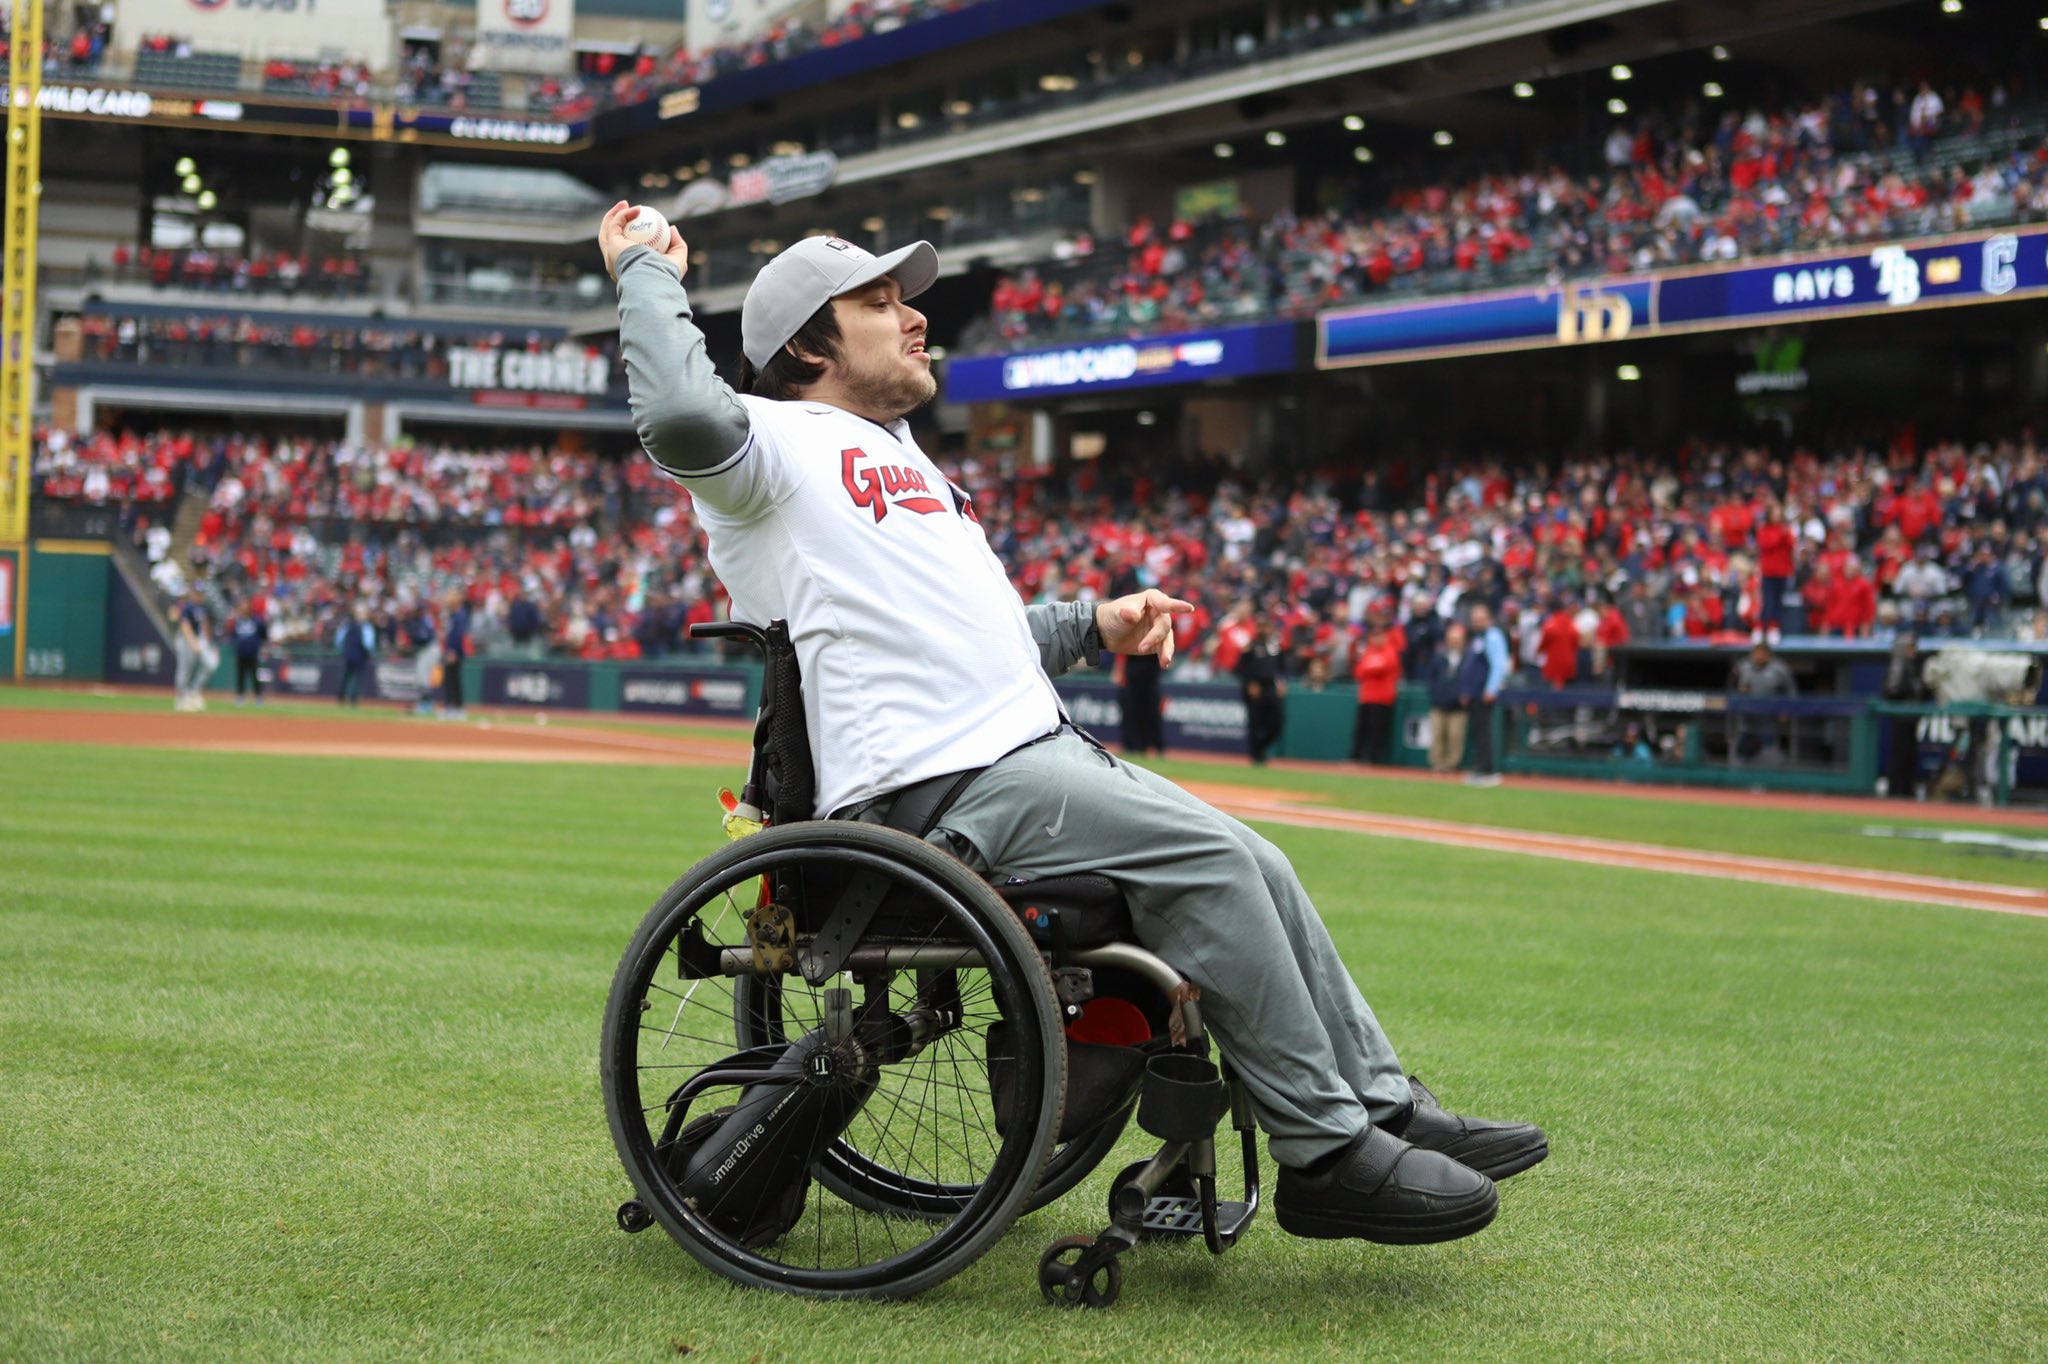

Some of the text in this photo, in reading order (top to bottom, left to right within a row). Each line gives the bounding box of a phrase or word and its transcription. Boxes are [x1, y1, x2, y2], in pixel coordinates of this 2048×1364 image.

[1773, 264, 1854, 304] RAYS
[447, 346, 610, 395] THE CORNER
[709, 1123, 765, 1185] SmartDrive
